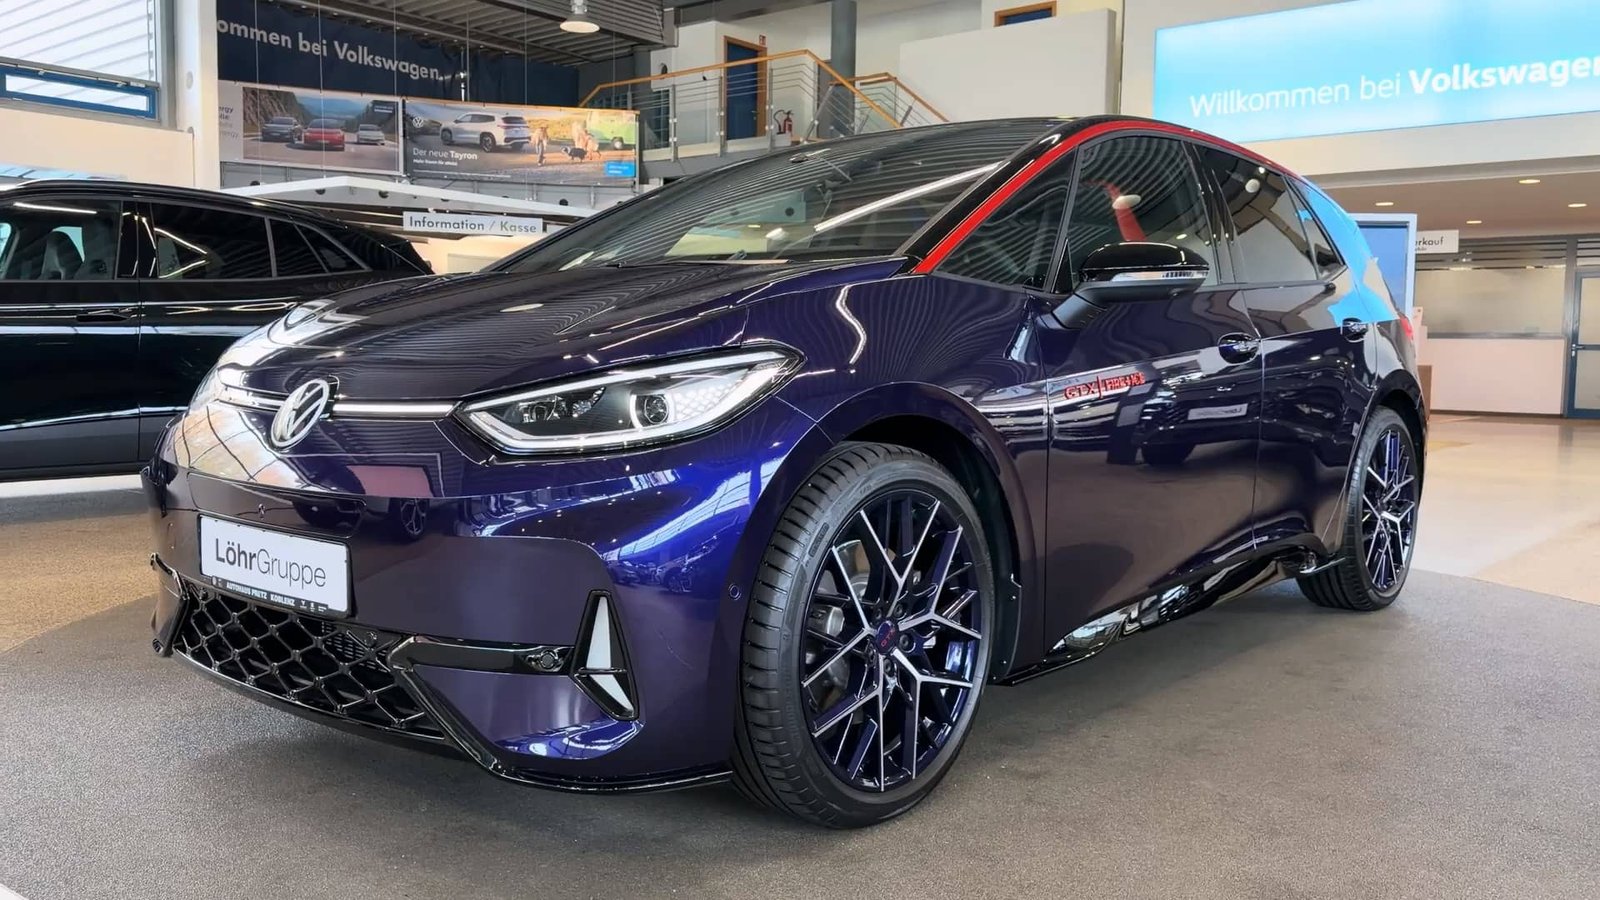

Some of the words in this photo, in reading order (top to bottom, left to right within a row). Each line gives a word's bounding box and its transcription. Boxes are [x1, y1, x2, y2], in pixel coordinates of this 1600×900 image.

[298, 31, 328, 57] bei
[1190, 83, 1350, 118] Willkommen
[1359, 73, 1401, 101] bei
[412, 148, 427, 156] Der
[428, 150, 449, 158] neue
[449, 150, 478, 161] Tayron
[409, 216, 485, 231] Information
[500, 221, 537, 233] Kasse
[215, 538, 326, 590] LöhrGruppe
